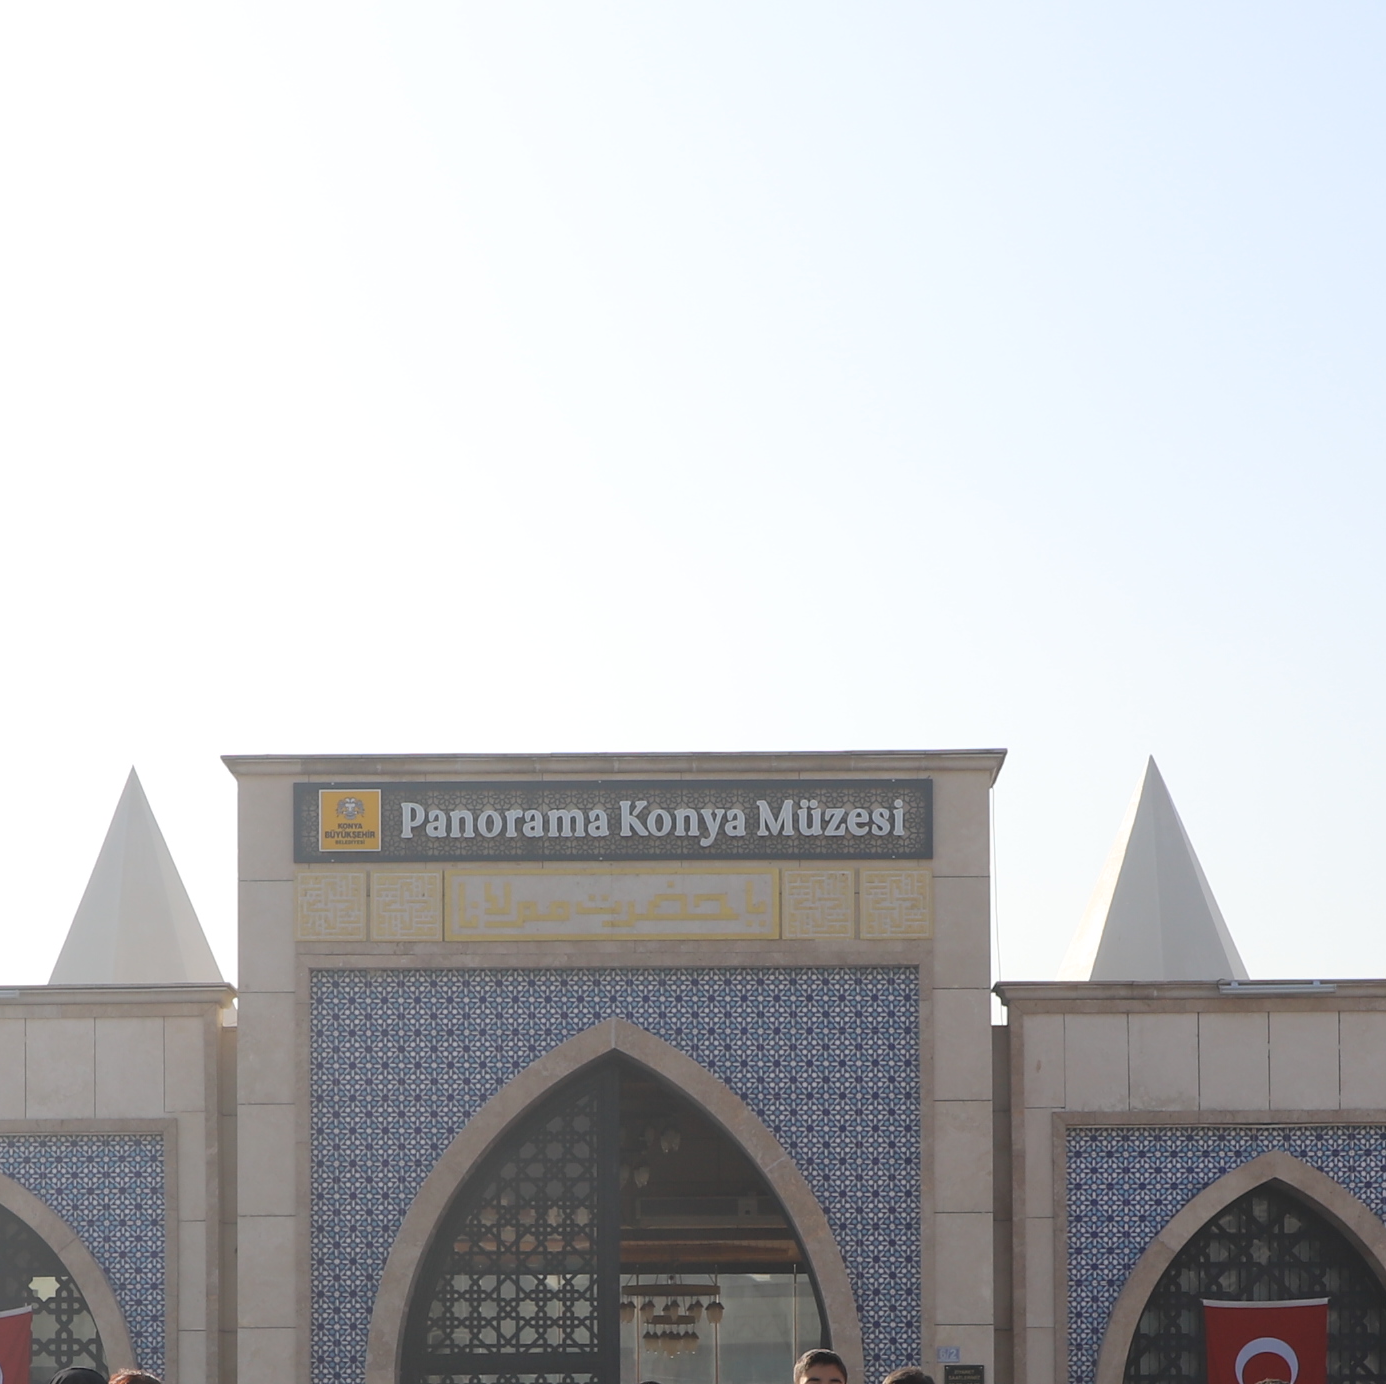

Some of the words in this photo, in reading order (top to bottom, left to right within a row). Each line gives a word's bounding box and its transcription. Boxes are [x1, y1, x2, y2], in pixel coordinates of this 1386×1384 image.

[400, 802, 609, 838] Panorama
[619, 800, 746, 846] Konya
[756, 799, 905, 836] Müzesi
[325, 829, 375, 839] BÜYÜKŞEHİR
[939, 1349, 957, 1359] 6/2
